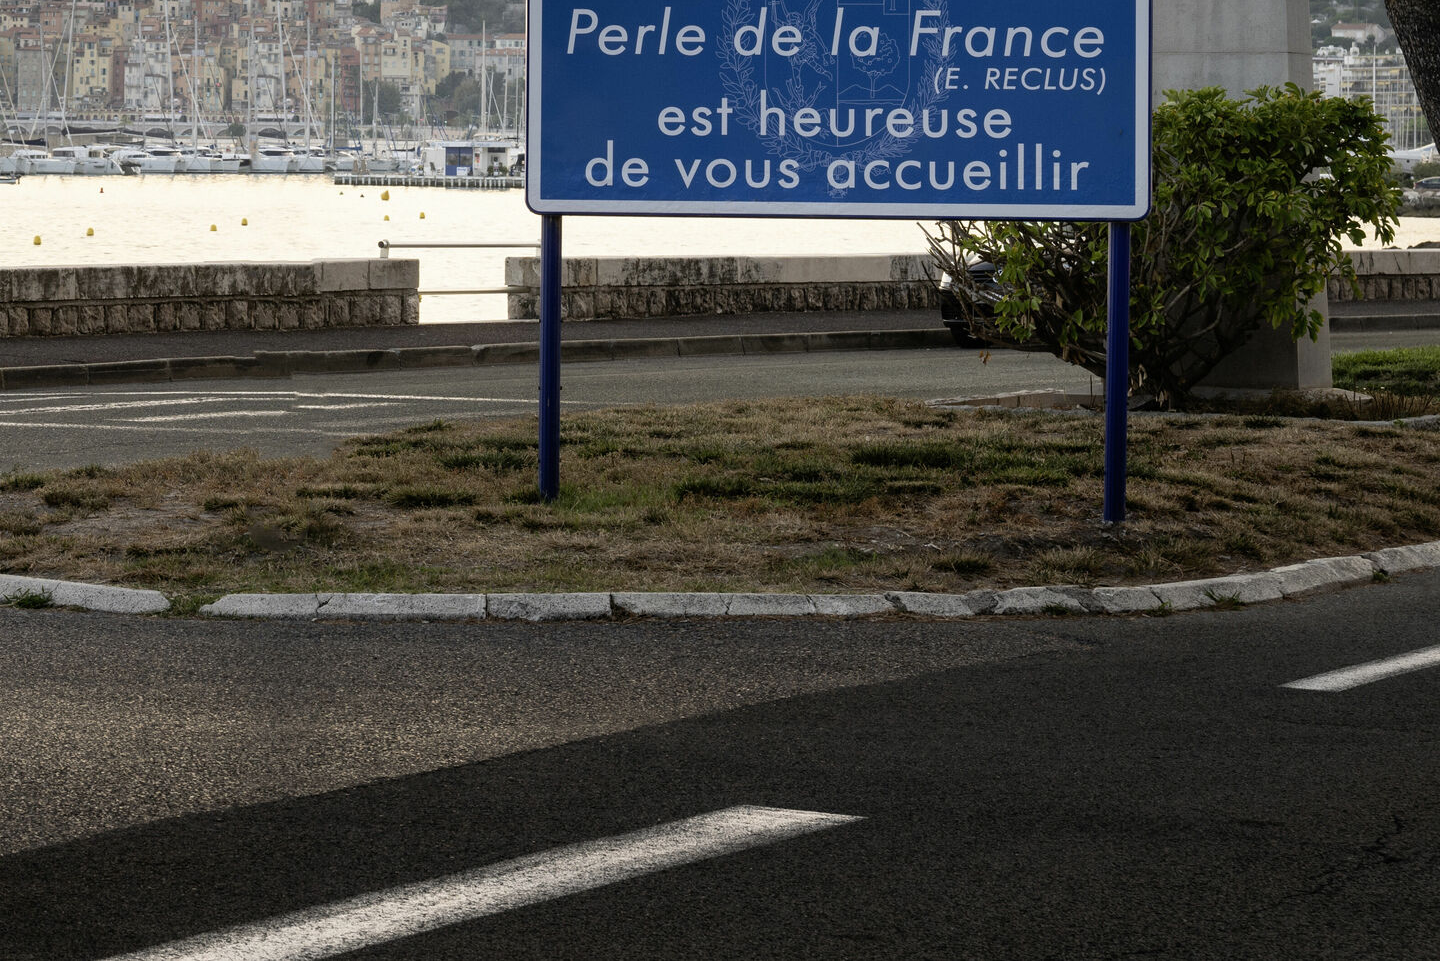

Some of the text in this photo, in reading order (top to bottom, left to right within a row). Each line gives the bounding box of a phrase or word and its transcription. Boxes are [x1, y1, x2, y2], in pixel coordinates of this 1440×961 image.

[567, 6, 1104, 58] Perle de la France
[933, 67, 1106, 95] (E. RECLUS)
[658, 89, 1012, 139] est heureuse
[585, 140, 1089, 191] de vous accueillir
